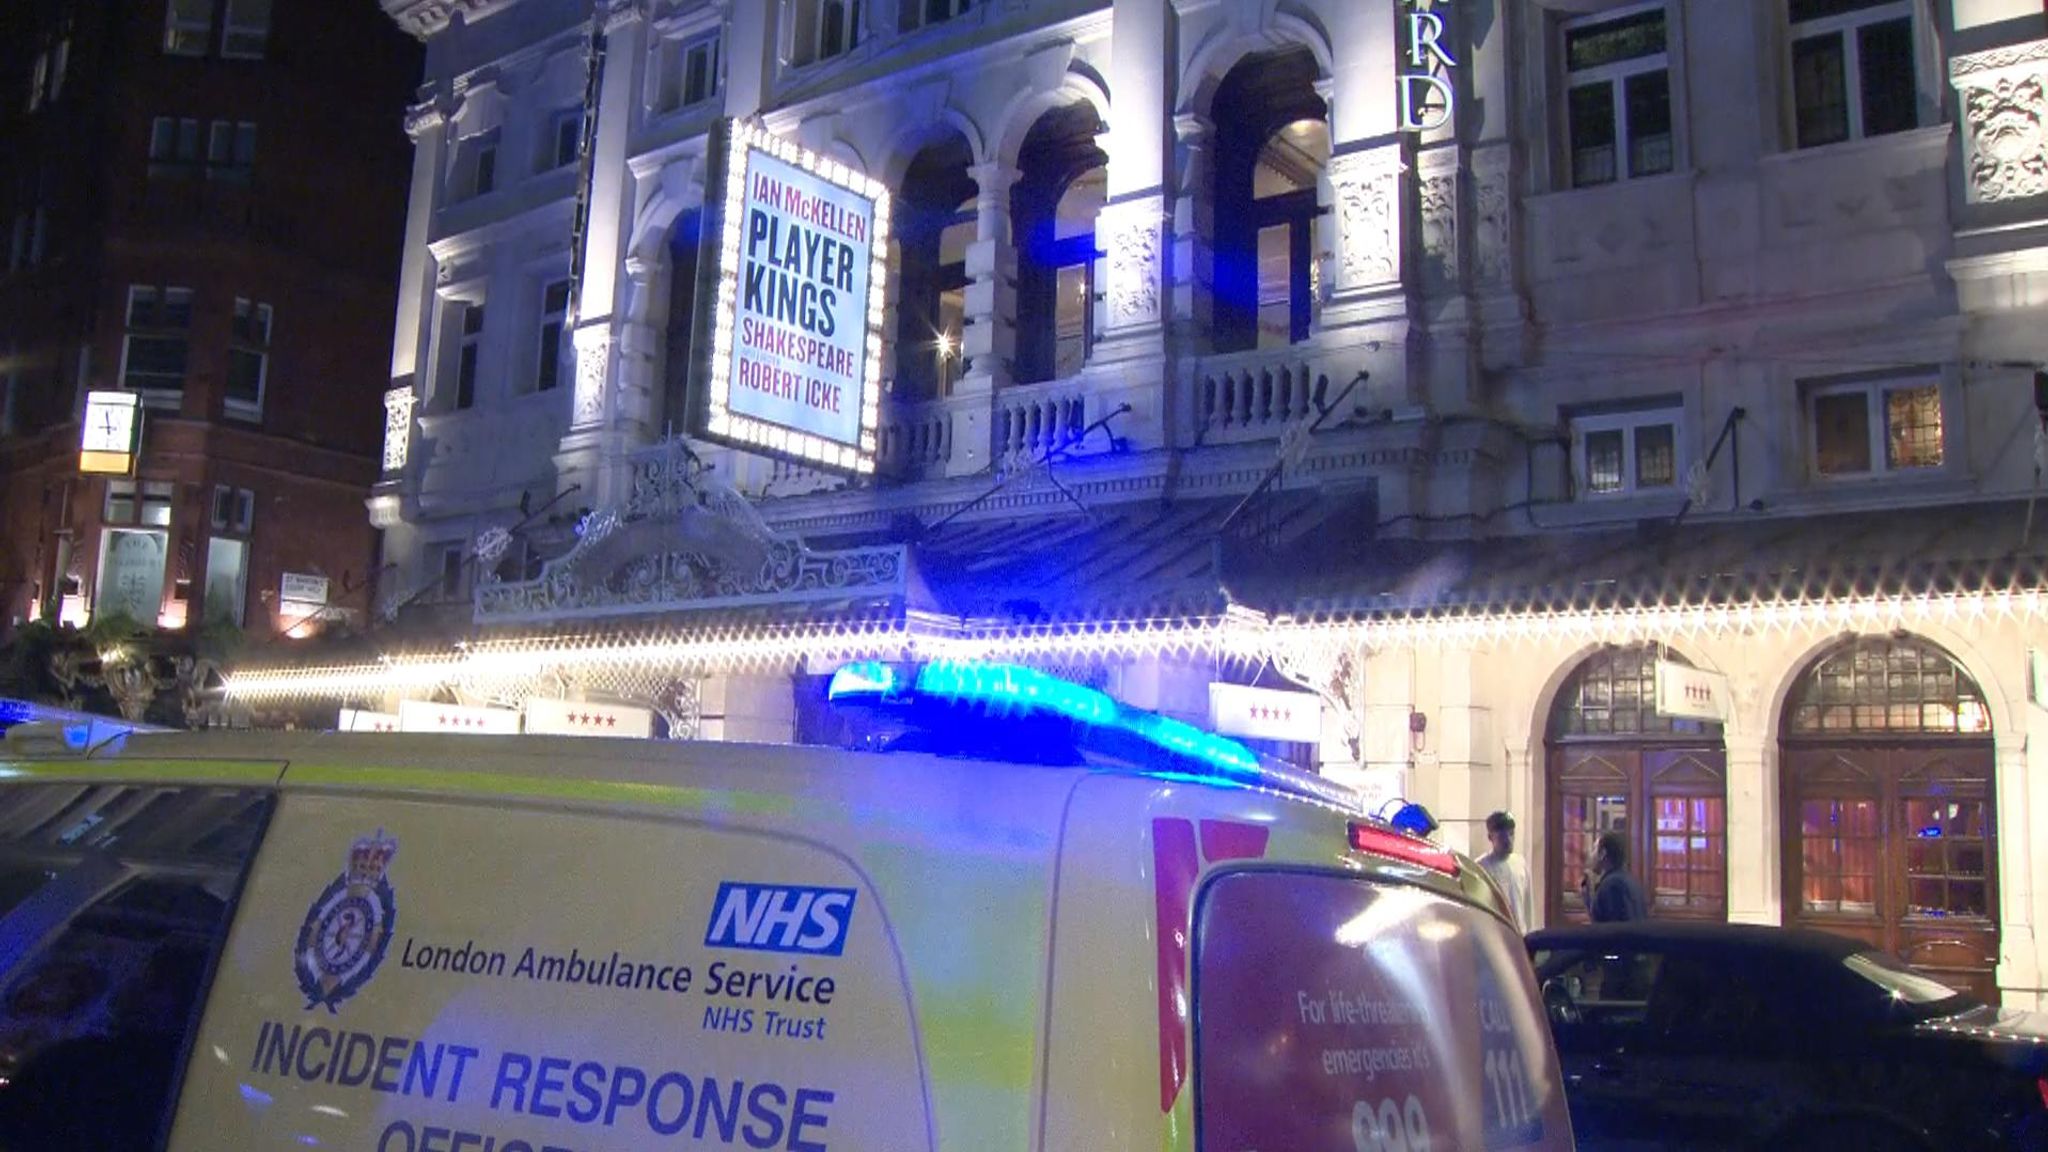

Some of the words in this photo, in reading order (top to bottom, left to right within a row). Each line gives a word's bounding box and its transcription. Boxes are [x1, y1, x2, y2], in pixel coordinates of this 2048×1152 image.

[1400, 0, 1456, 131] RD
[753, 172, 782, 209] IAN
[785, 186, 866, 243] McKELLEN
[748, 207, 854, 294] PLAYER
[744, 259, 837, 337] KINGS
[742, 316, 854, 378] SHAKESPEARE
[739, 356, 802, 402] ROBERT
[805, 376, 841, 414] ICKE
[709, 888, 851, 950] NHS
[401, 937, 505, 976] London
[513, 947, 693, 993] Ambulance
[705, 962, 835, 1005] Service
[703, 1006, 755, 1034] NHS
[764, 1010, 826, 1041] Trust
[1297, 990, 1326, 1024] For
[252, 1021, 479, 1103] INCIDENT
[1322, 1038, 1413, 1082] emergencies
[1485, 1048, 1529, 1129] 111
[490, 1051, 835, 1152] RESPONSE
